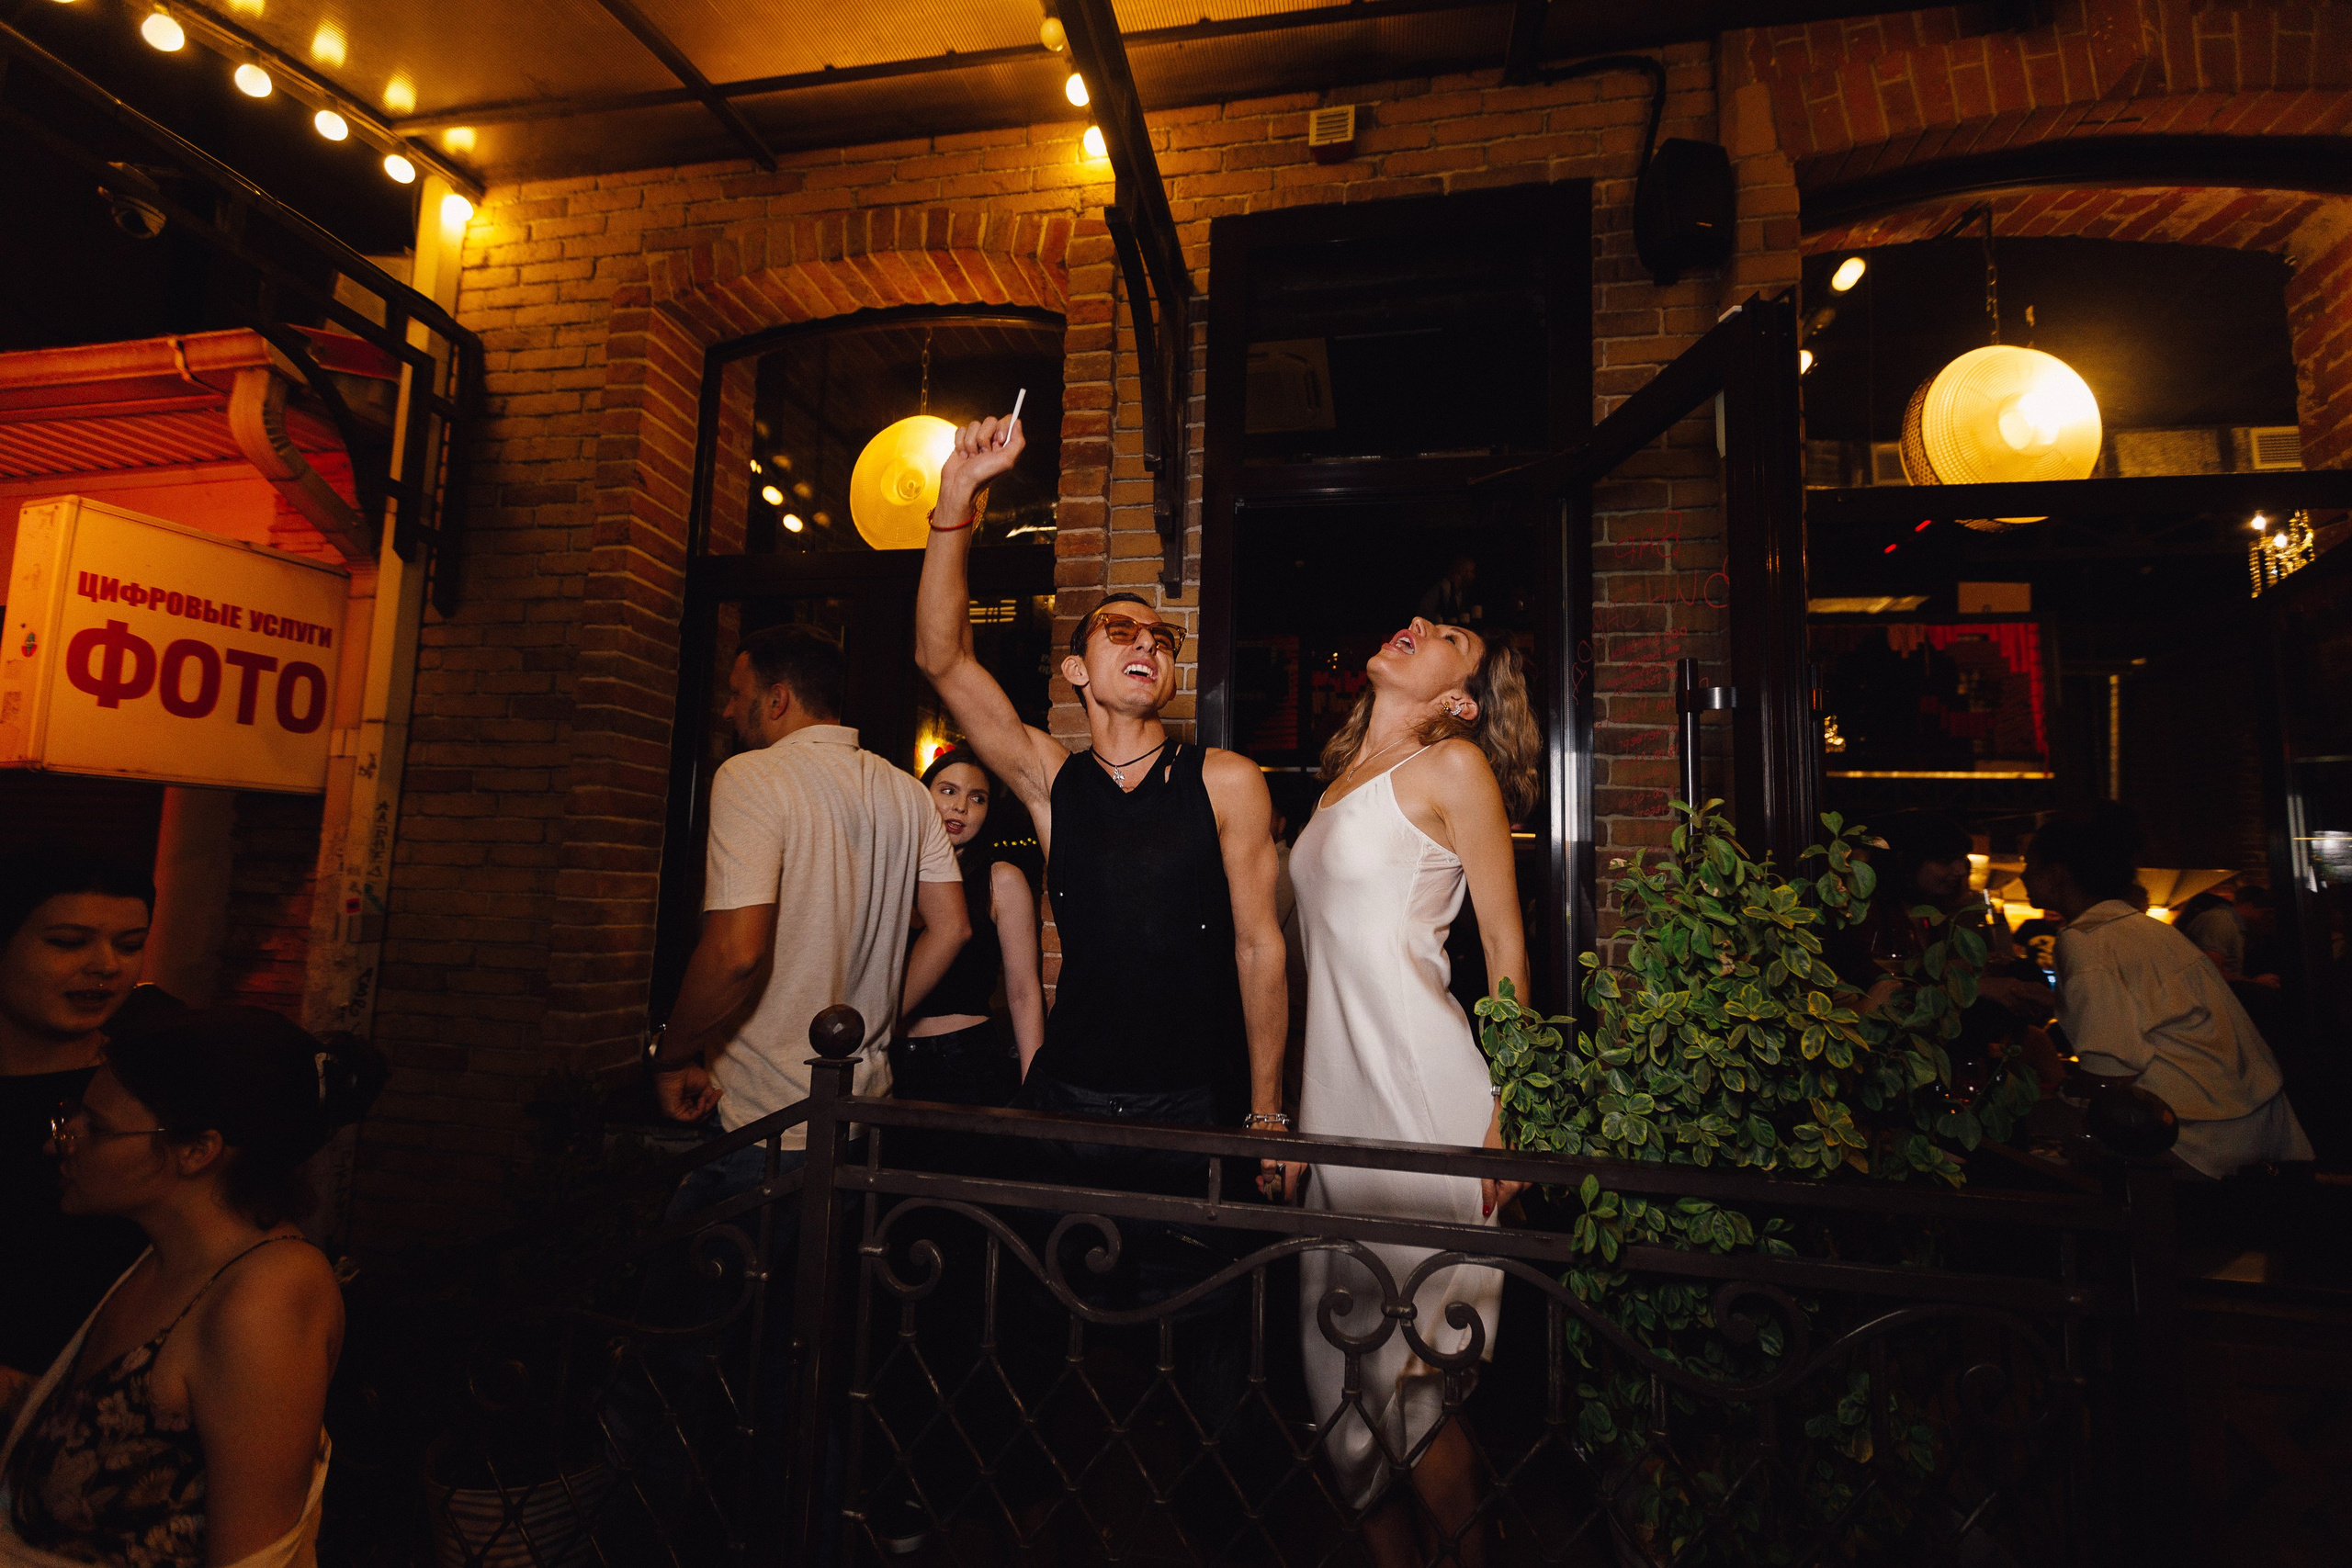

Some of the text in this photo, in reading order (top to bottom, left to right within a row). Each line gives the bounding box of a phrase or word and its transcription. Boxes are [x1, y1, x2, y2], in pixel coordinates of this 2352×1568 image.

[77, 570, 333, 649] ЦИФРОВЫЕ УСЛУГИ
[66, 619, 327, 734] ФОТО
